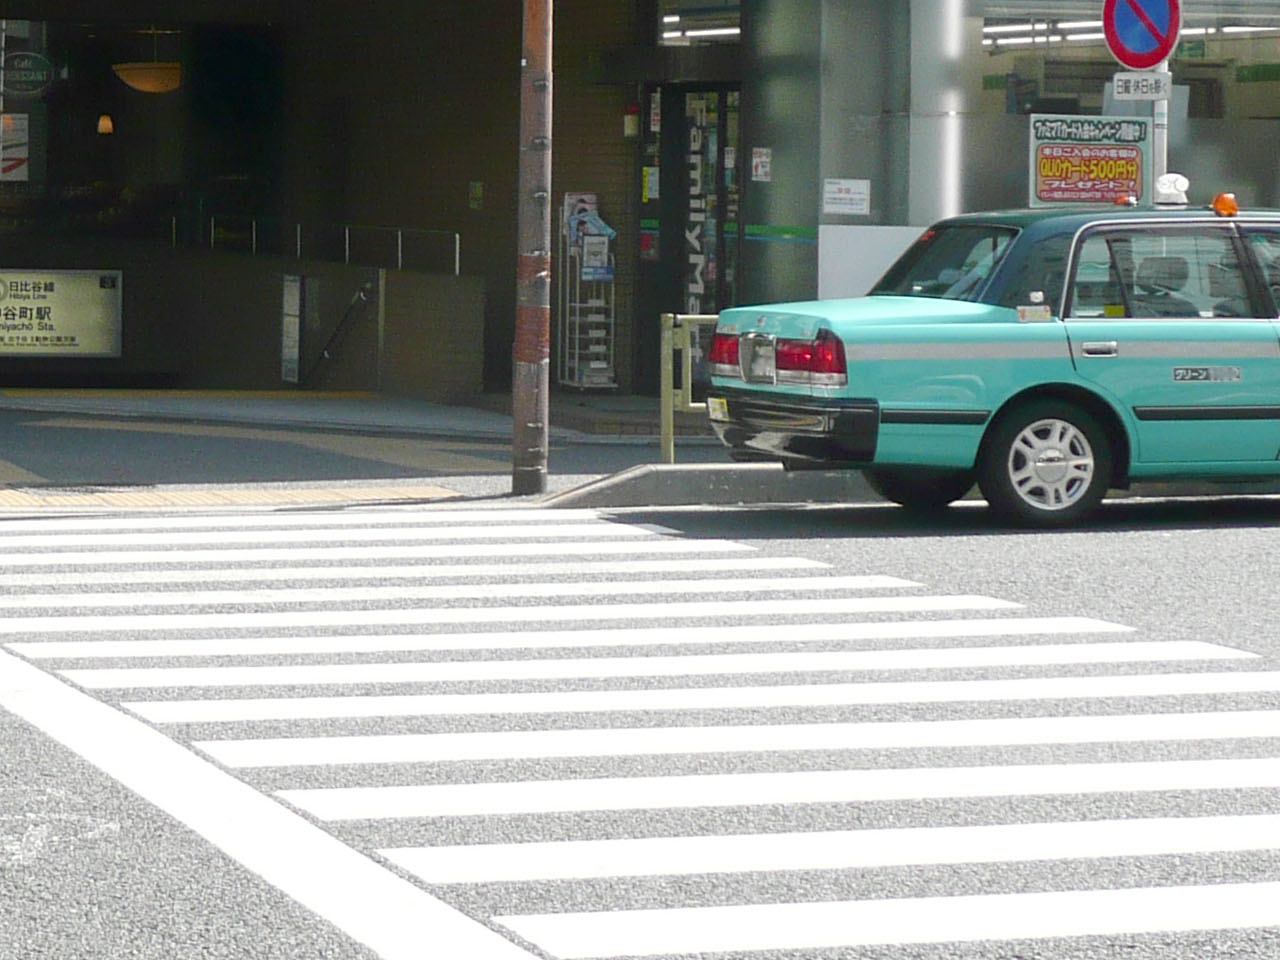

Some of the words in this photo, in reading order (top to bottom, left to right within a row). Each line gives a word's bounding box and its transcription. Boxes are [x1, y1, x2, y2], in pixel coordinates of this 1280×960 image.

[9, 280, 55, 293] 日比谷線
[685, 92, 707, 364] FamilyMat
